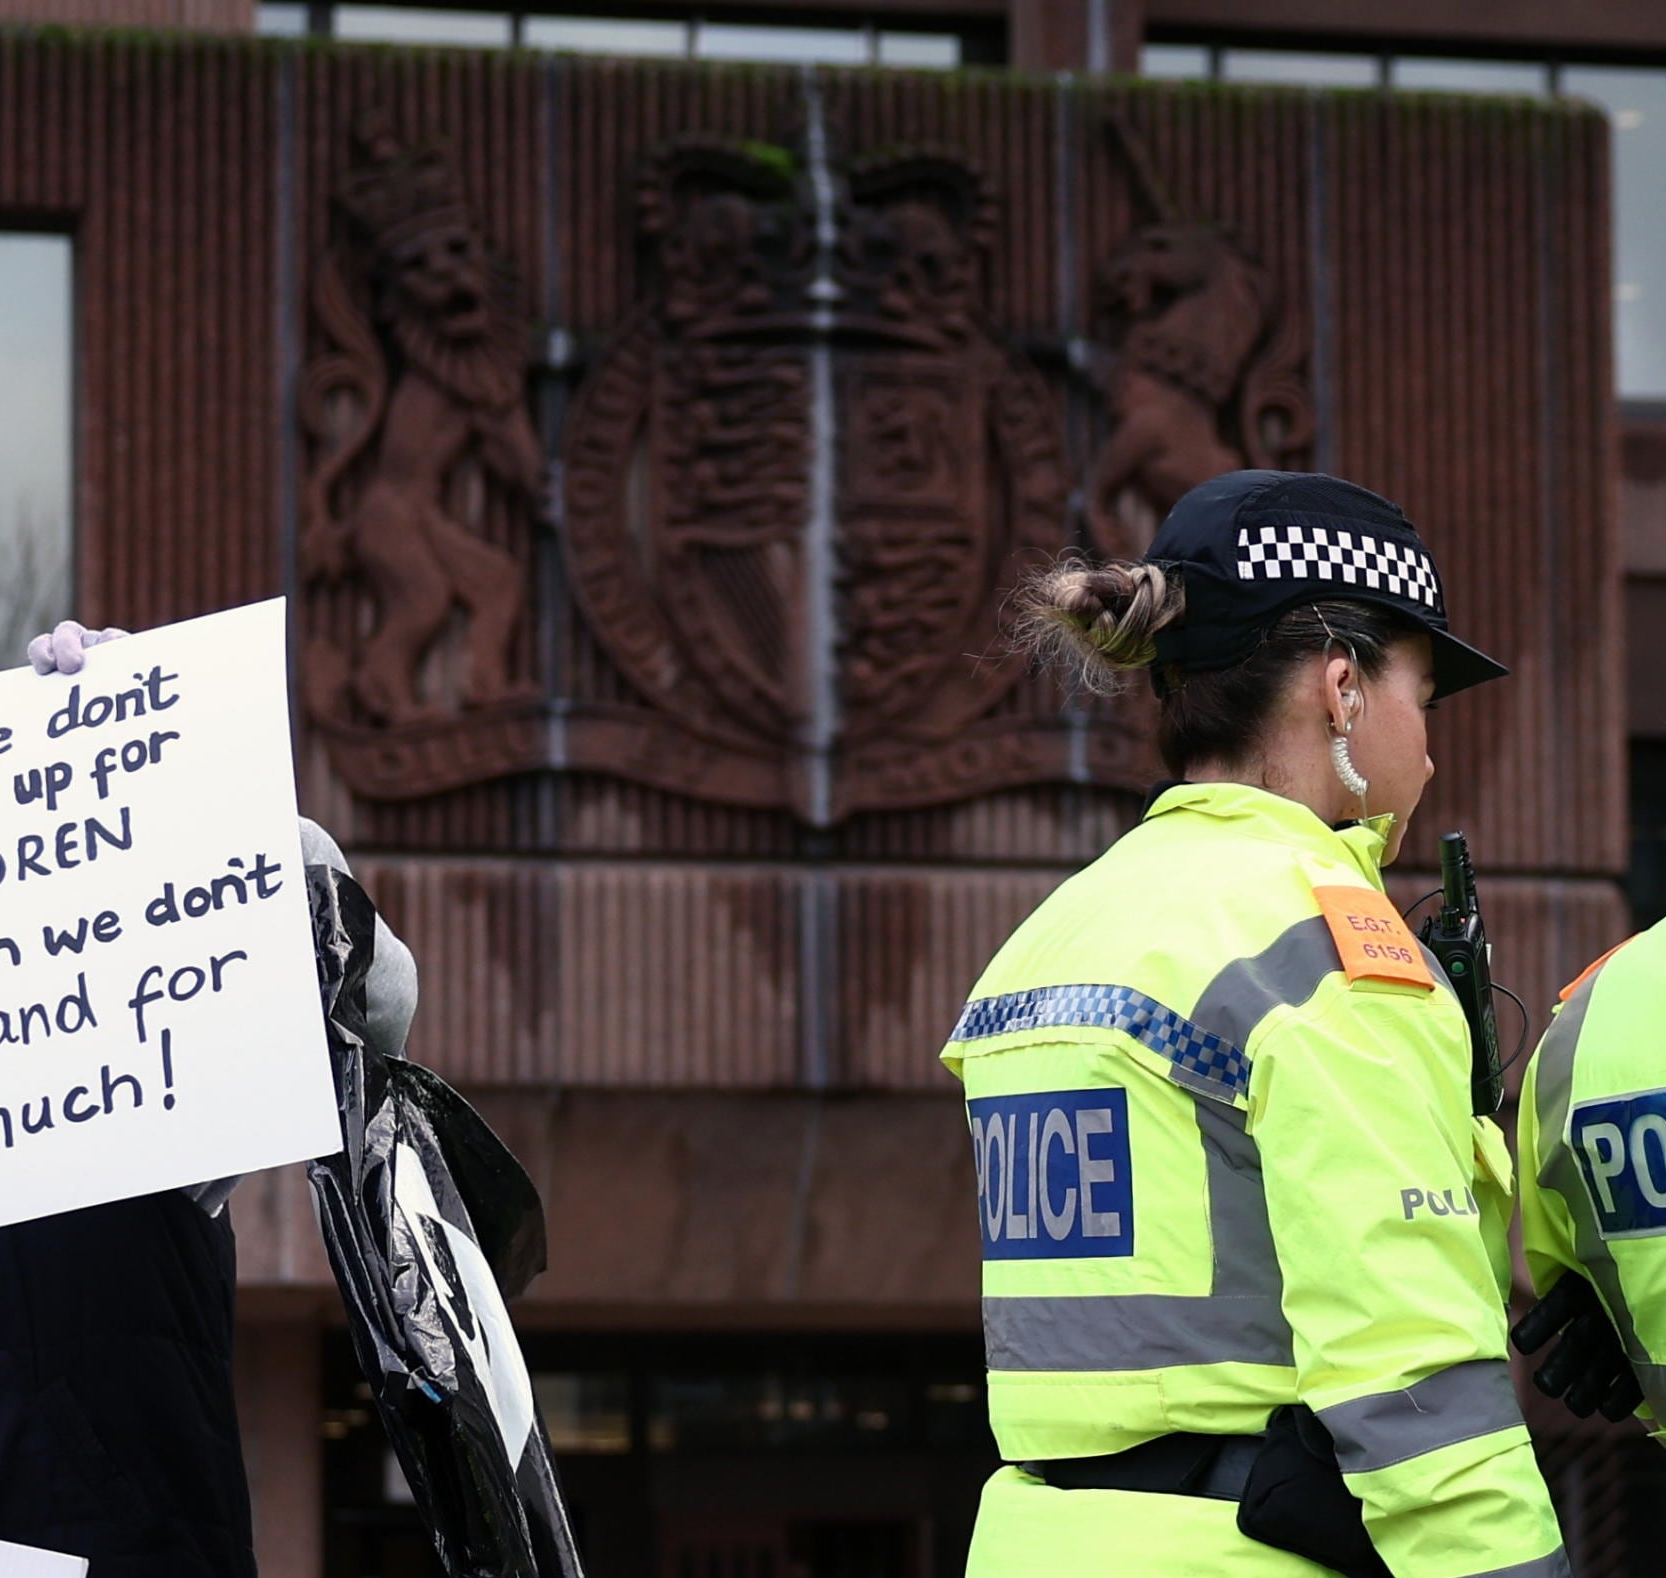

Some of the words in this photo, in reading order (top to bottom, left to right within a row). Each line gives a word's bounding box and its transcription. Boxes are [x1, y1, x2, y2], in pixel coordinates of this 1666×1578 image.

[46, 665, 181, 740] don't
[13, 761, 73, 811] up
[89, 730, 181, 800] for
[42, 910, 123, 957] we
[145, 852, 284, 928] don't
[1363, 943, 1413, 965] 6156
[128, 948, 249, 1044] for
